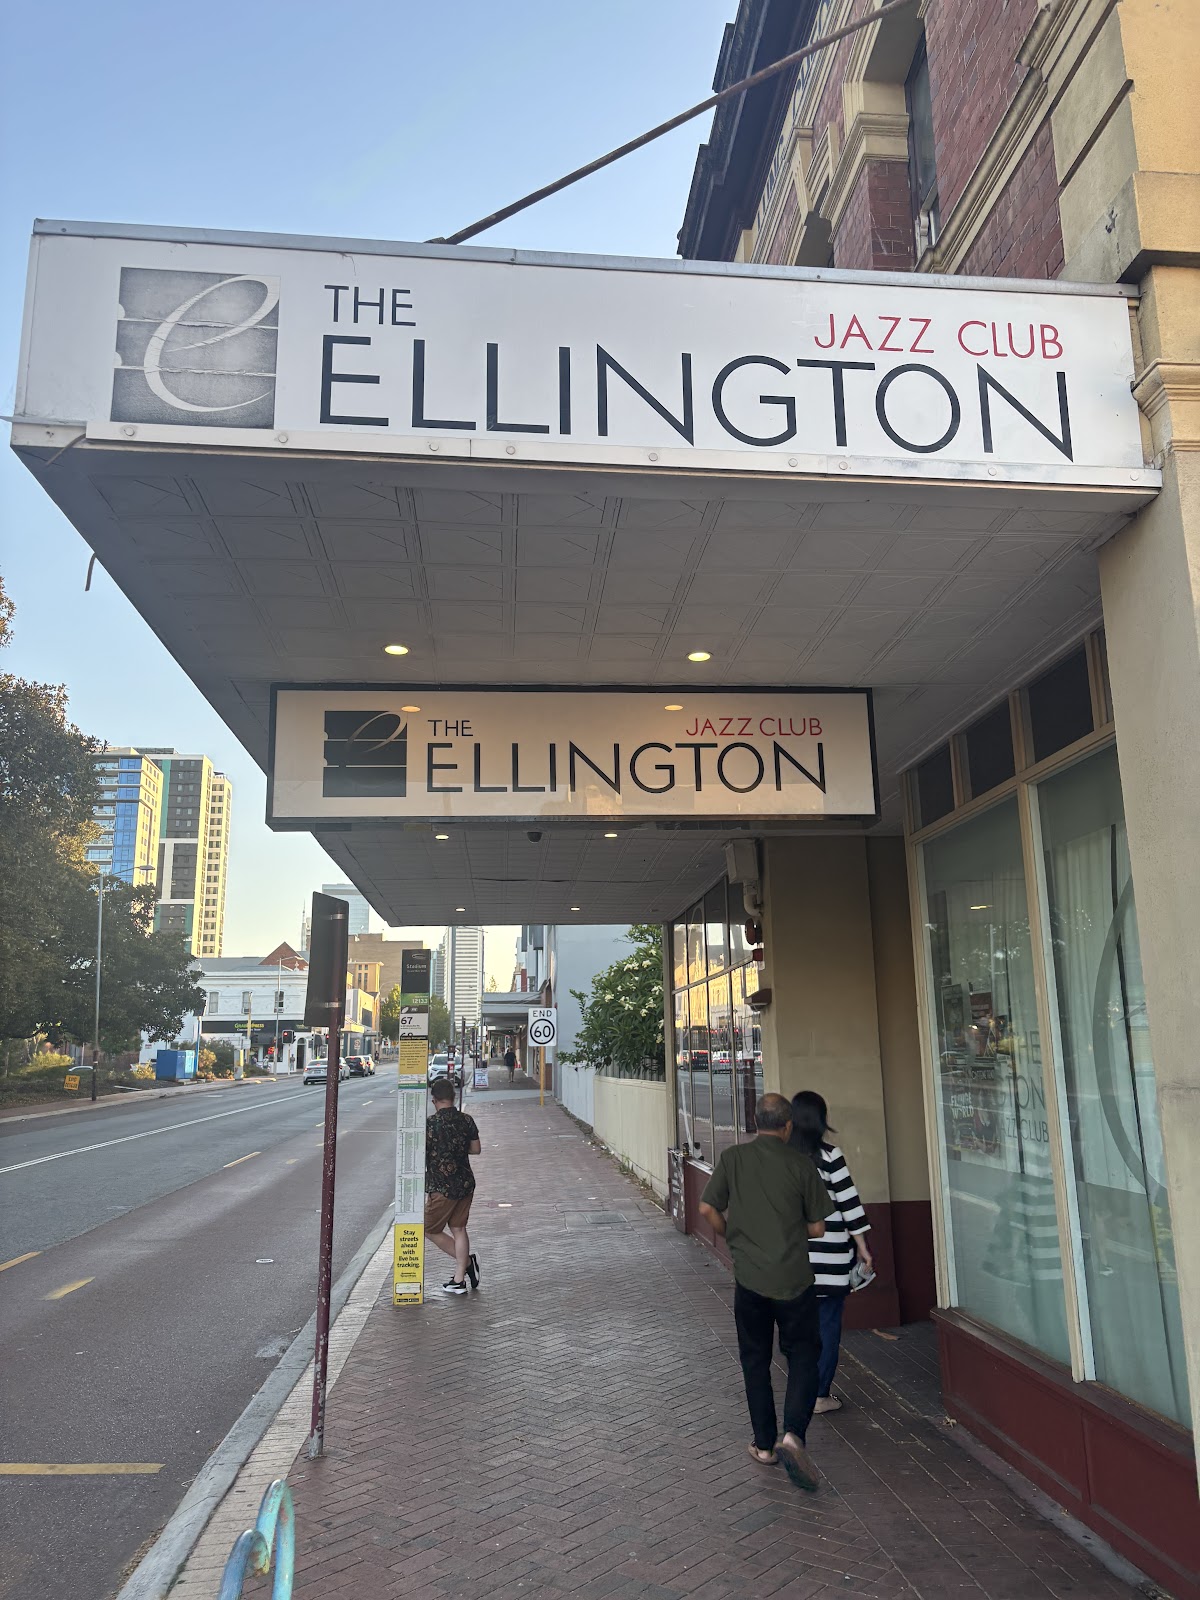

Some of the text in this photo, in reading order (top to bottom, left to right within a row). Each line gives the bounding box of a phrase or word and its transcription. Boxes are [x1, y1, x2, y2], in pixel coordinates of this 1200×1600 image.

[324, 284, 417, 327] THE
[814, 313, 1064, 360] JAZZ CLUB
[319, 334, 1074, 463] ELLINGTON
[427, 719, 474, 737] THE
[686, 717, 823, 737] JAZZ CLUB
[426, 740, 827, 795] ELLINGTON
[400, 1016, 413, 1025] 67
[534, 1025, 551, 1038] 60
[1020, 1118, 1050, 1143] CLUB
